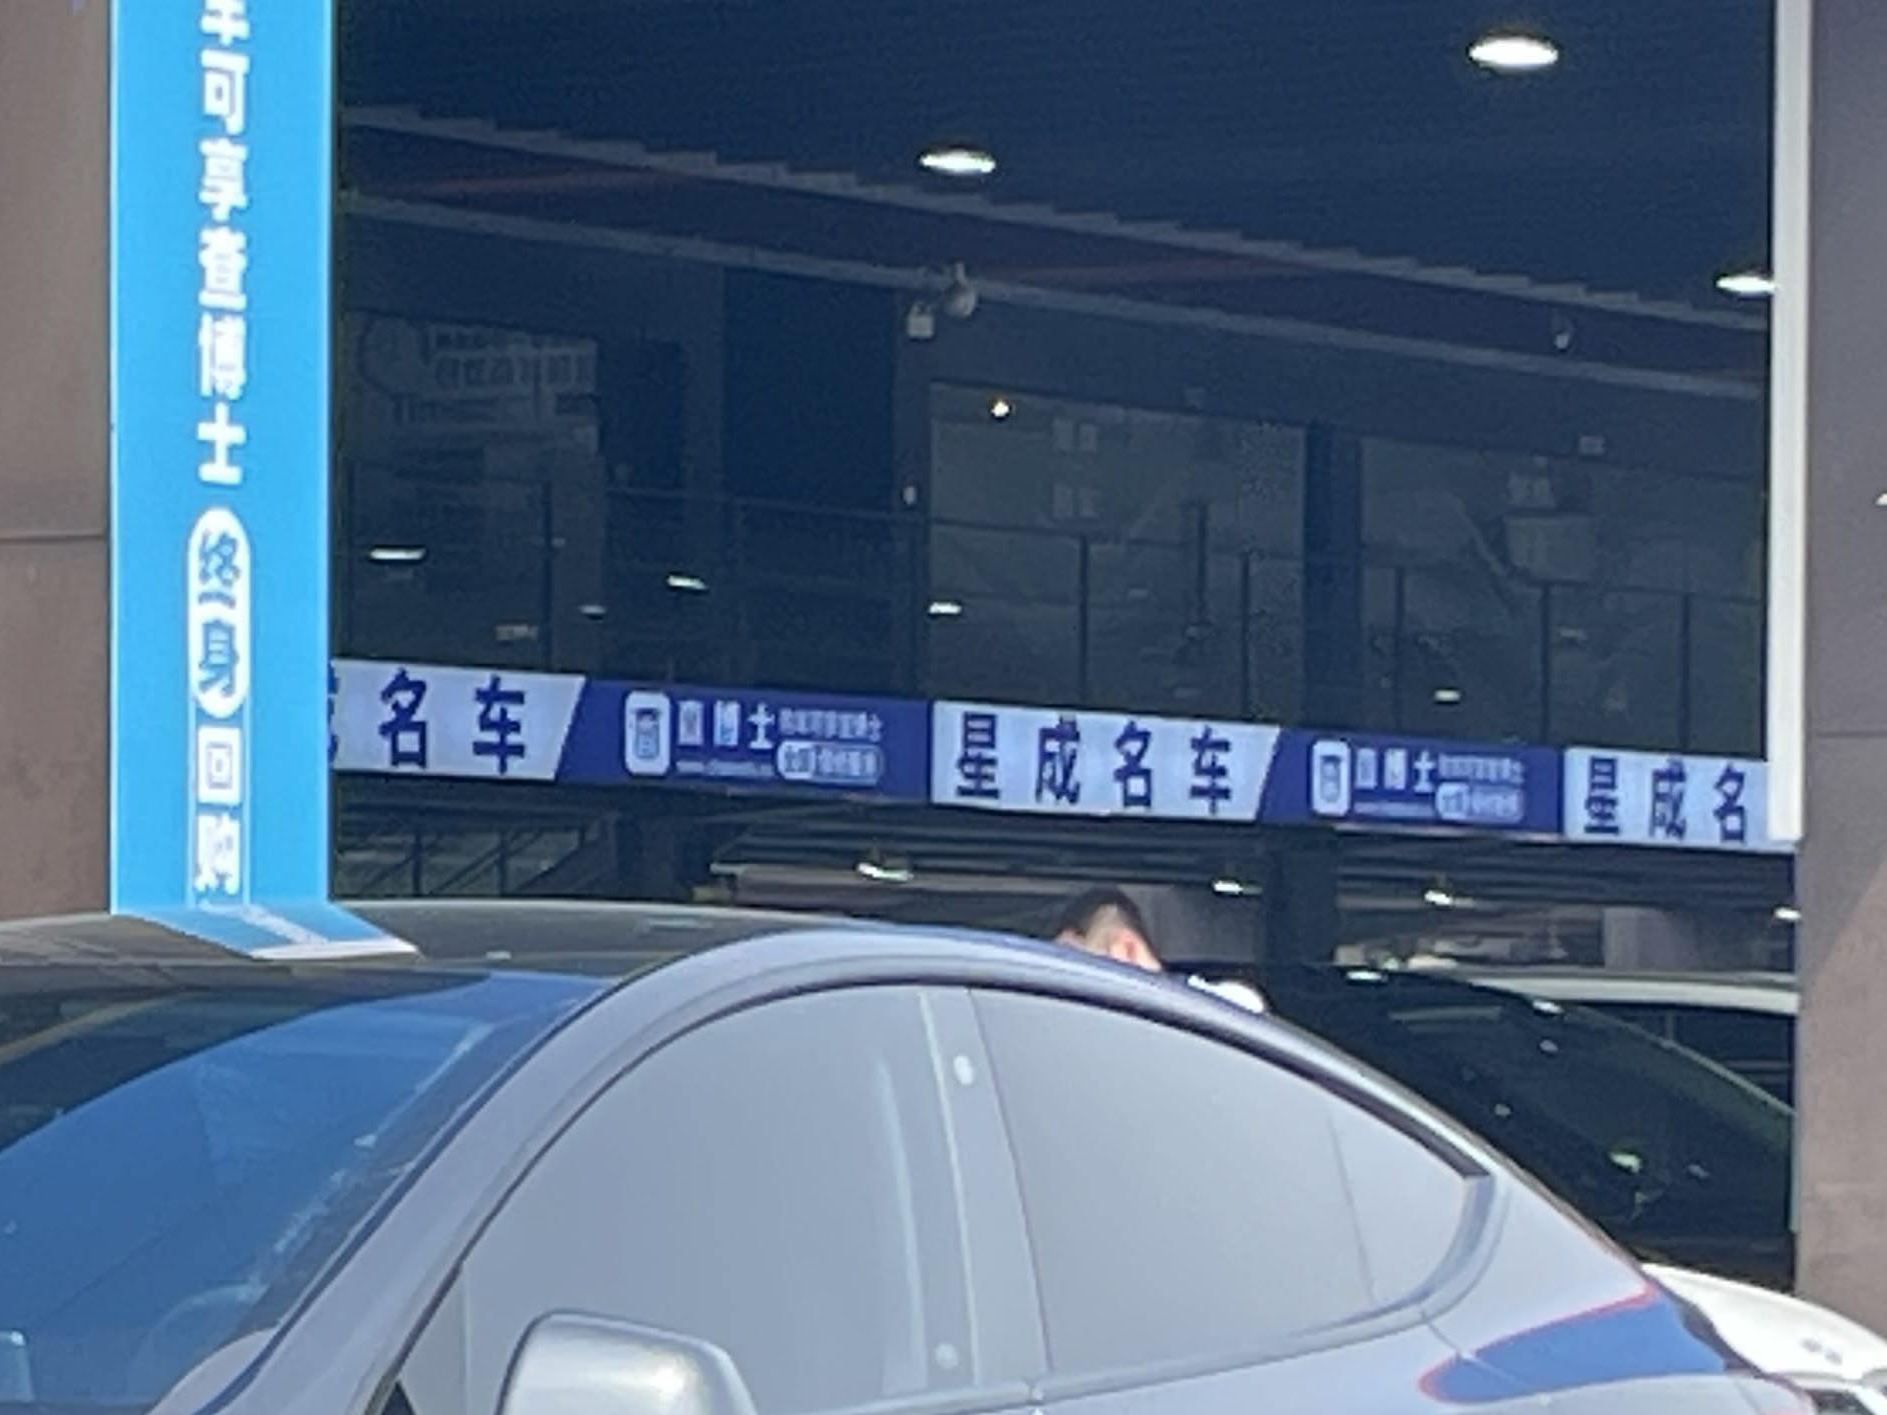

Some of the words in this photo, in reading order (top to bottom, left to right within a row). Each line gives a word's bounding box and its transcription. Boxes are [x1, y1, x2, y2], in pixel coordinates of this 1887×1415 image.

[328, 662, 525, 775] 名车
[956, 711, 1233, 814] 星成名车
[1584, 755, 1746, 844] 星成名
